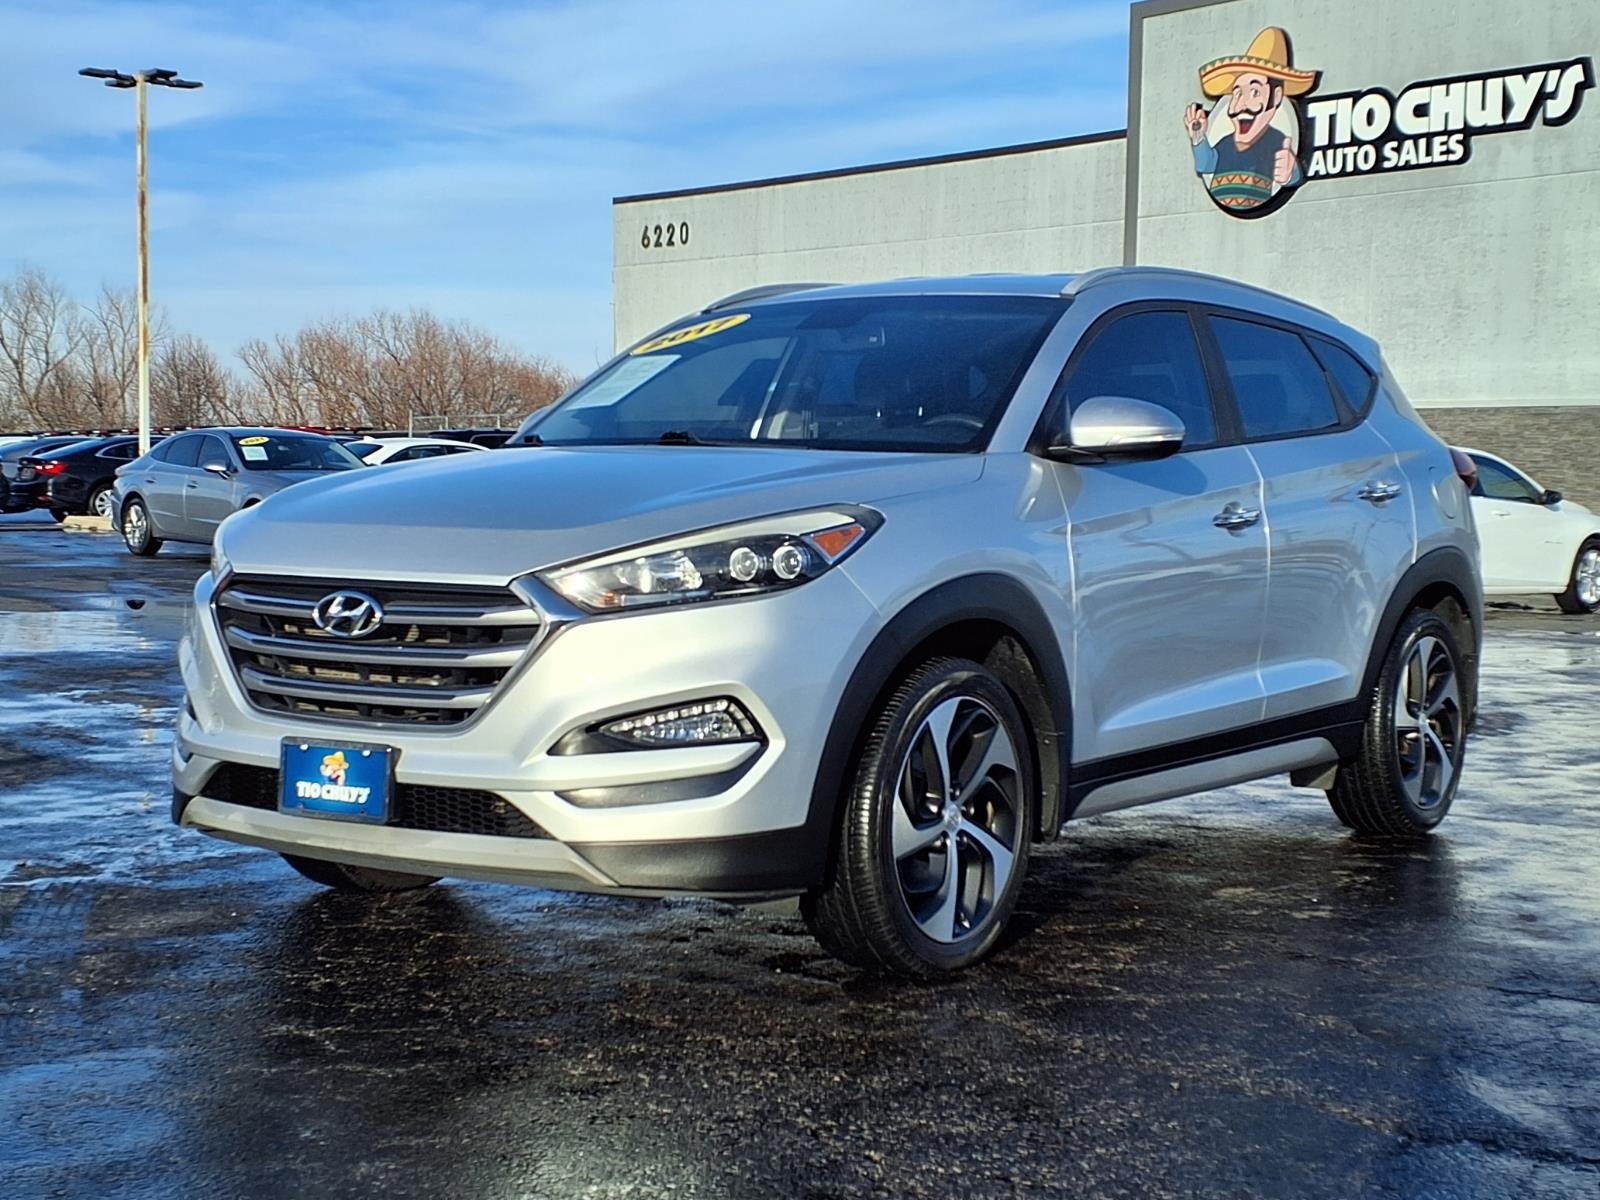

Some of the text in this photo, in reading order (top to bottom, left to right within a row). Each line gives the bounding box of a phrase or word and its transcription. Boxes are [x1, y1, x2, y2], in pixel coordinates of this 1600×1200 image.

[1307, 63, 1585, 147] TIO CHUY'S
[1307, 134, 1464, 177] AUTO SALES
[641, 221, 689, 249] 6220
[296, 781, 320, 798] TIO
